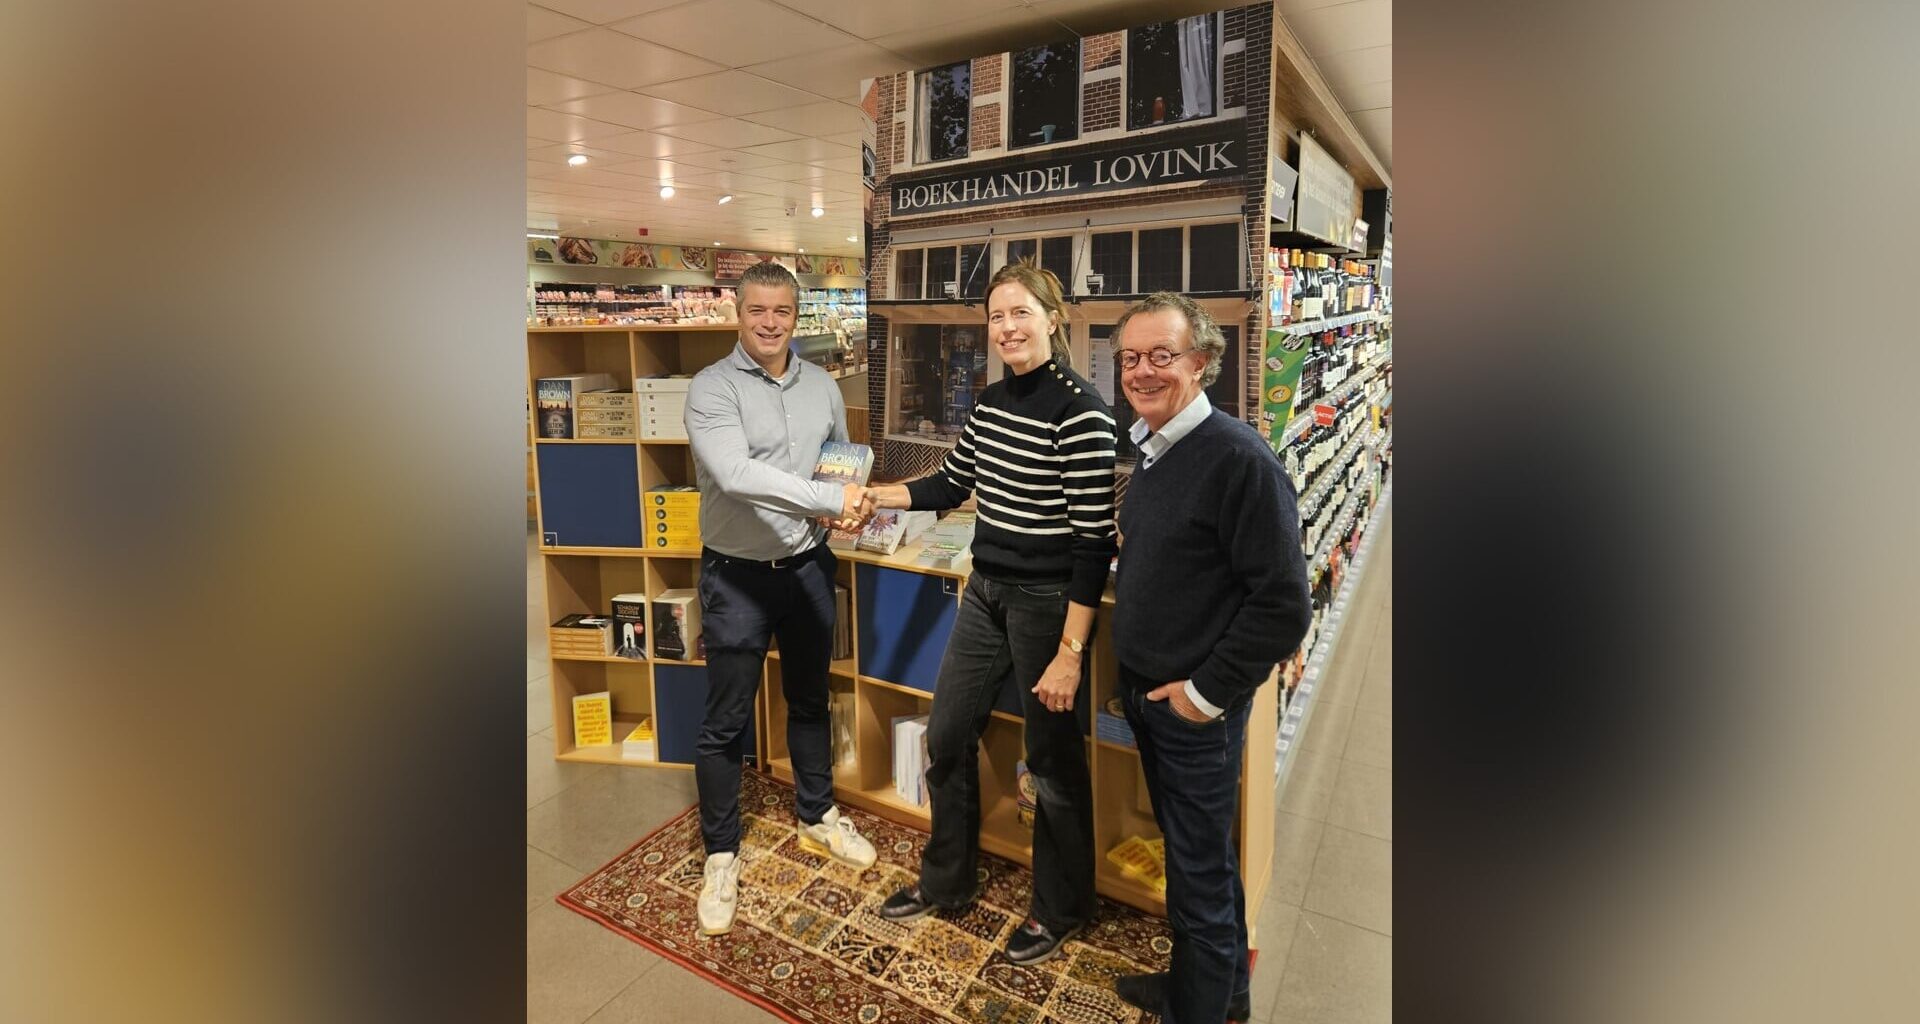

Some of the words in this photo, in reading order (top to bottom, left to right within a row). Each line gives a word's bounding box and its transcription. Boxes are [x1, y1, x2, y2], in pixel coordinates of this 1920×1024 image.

[897, 164, 1079, 210] BOEKHANDEL
[1093, 140, 1239, 186] LOVINK
[543, 381, 565, 390] DAN
[538, 390, 571, 400] BROWN
[831, 443, 860, 455] DAN
[821, 452, 865, 466] BROWN
